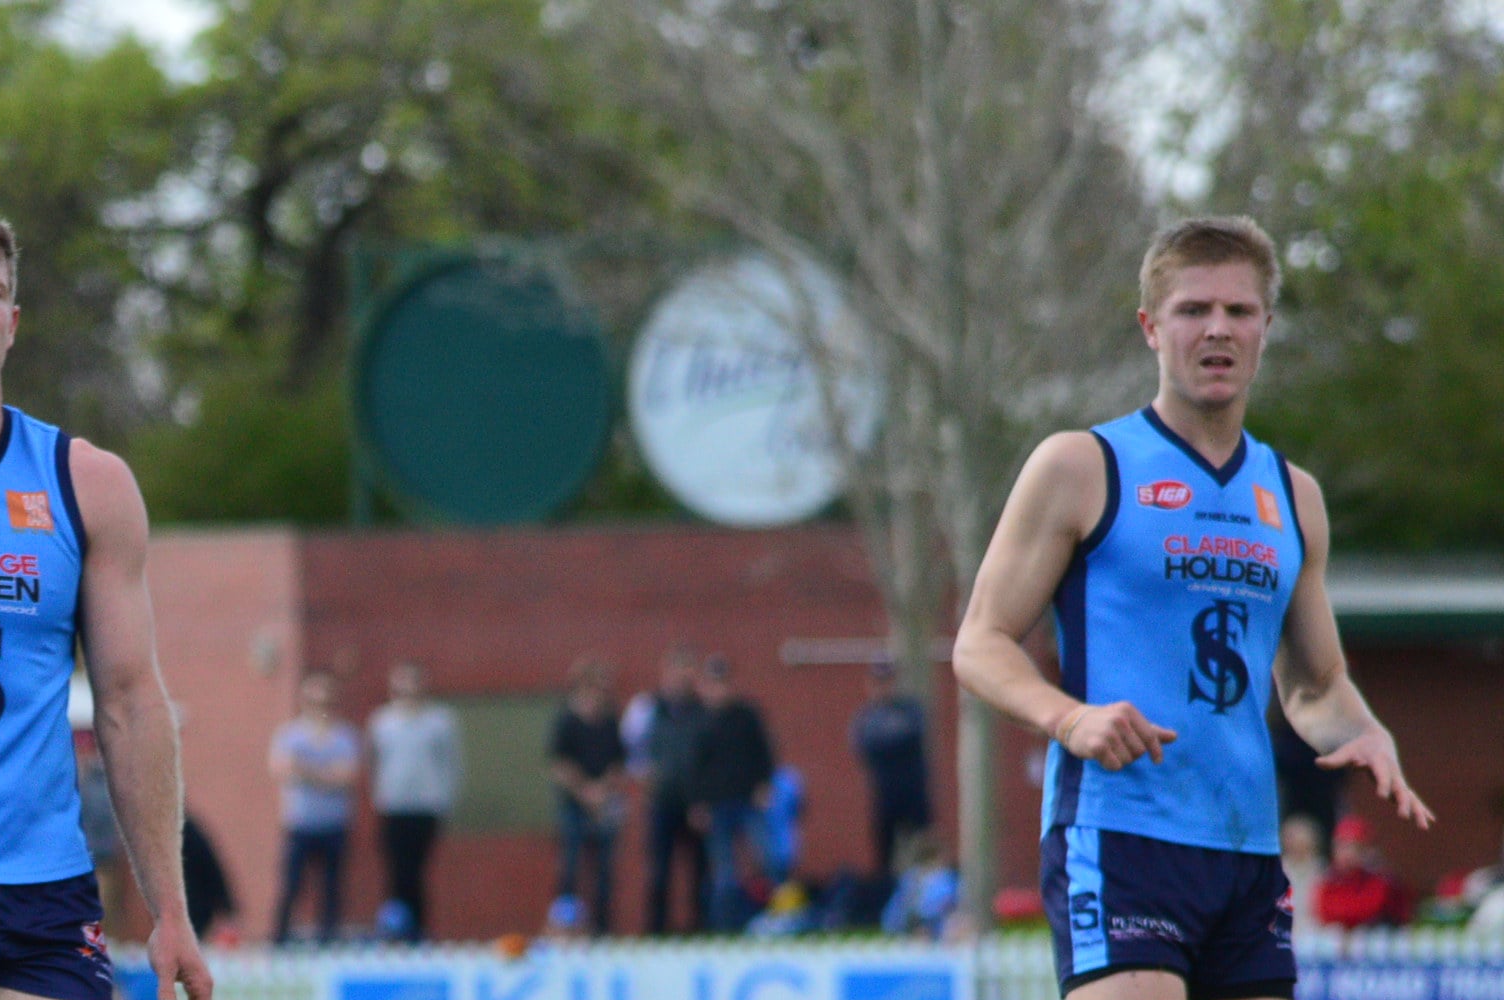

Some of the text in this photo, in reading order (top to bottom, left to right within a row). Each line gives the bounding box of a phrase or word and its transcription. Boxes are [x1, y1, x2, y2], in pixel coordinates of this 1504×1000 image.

[1156, 488, 1188, 502] IGA
[1164, 535, 1279, 568] CLARIDGE
[1164, 556, 1279, 592] HOLDEN
